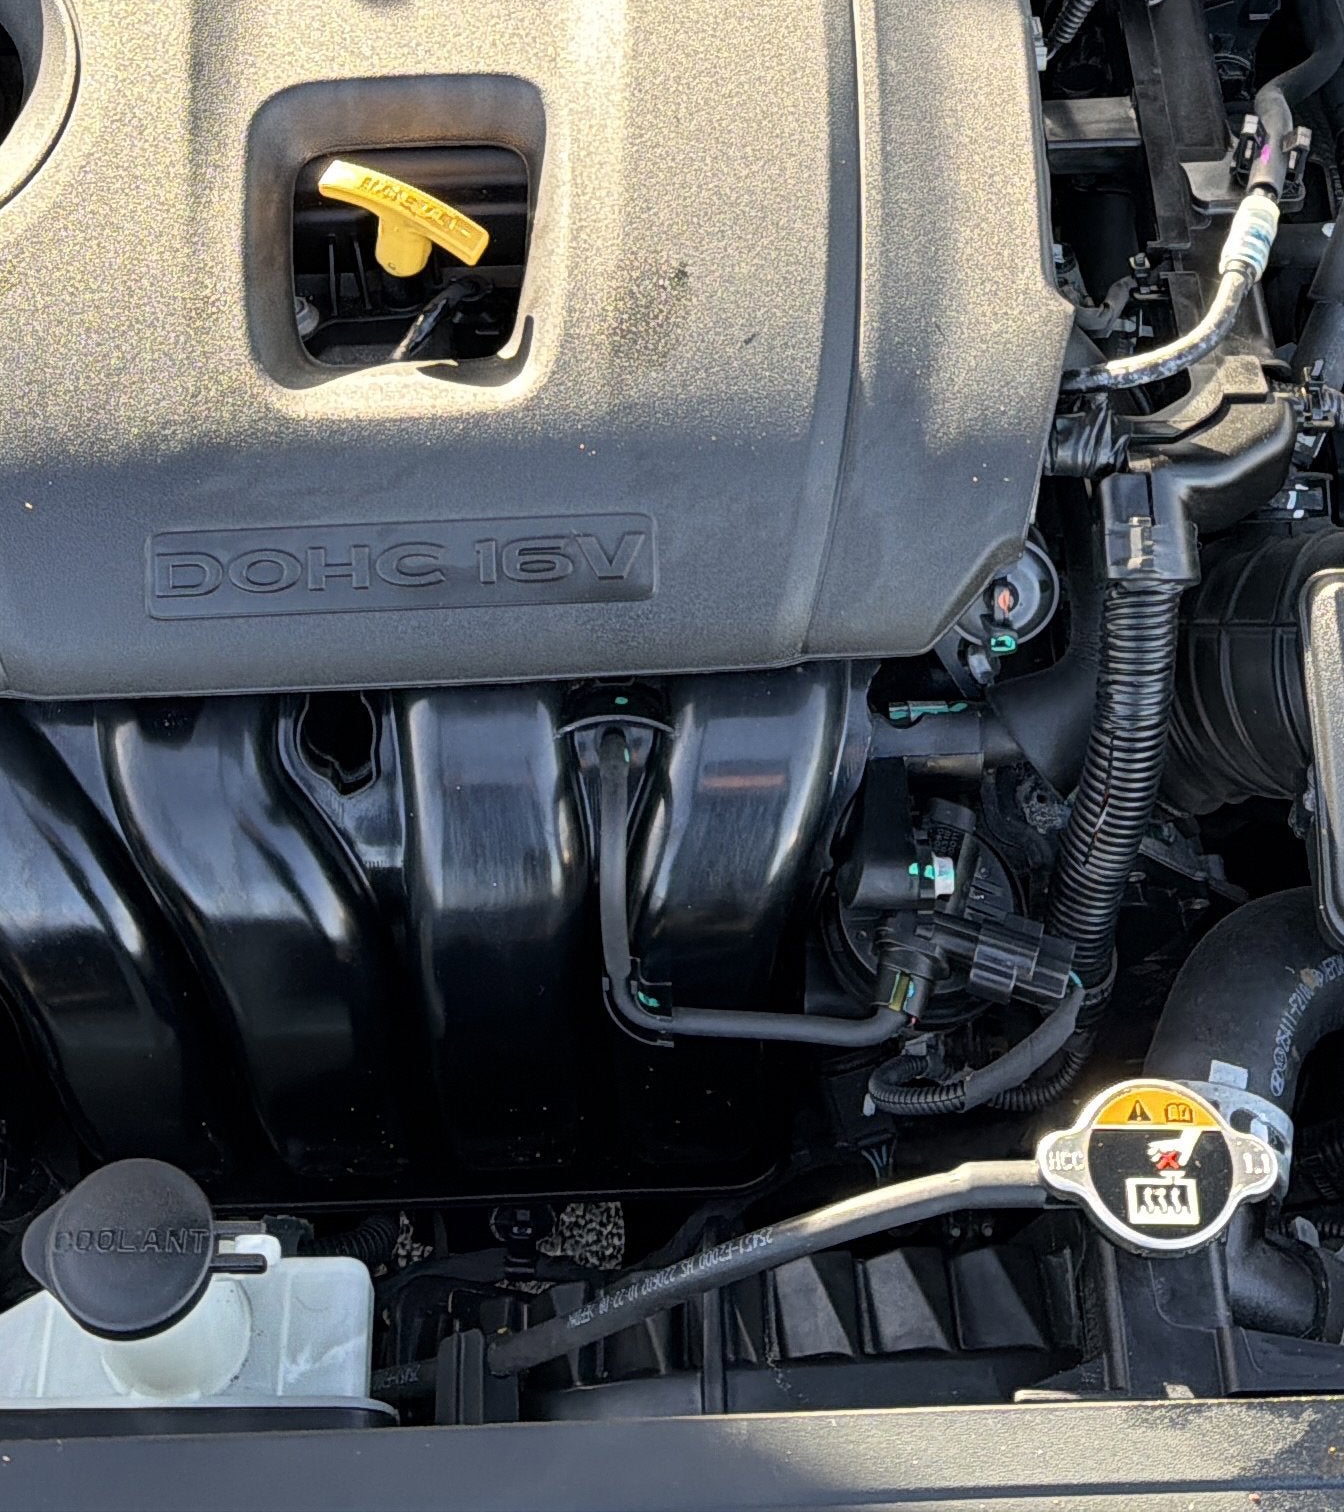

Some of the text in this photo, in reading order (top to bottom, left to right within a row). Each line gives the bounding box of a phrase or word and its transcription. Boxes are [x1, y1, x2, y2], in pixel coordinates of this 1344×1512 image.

[155, 531, 646, 599] DOHC 16V
[1049, 1151, 1085, 1171] HCC
[1242, 1152, 1271, 1174] 1.1
[52, 1228, 210, 1254] COOLANT
